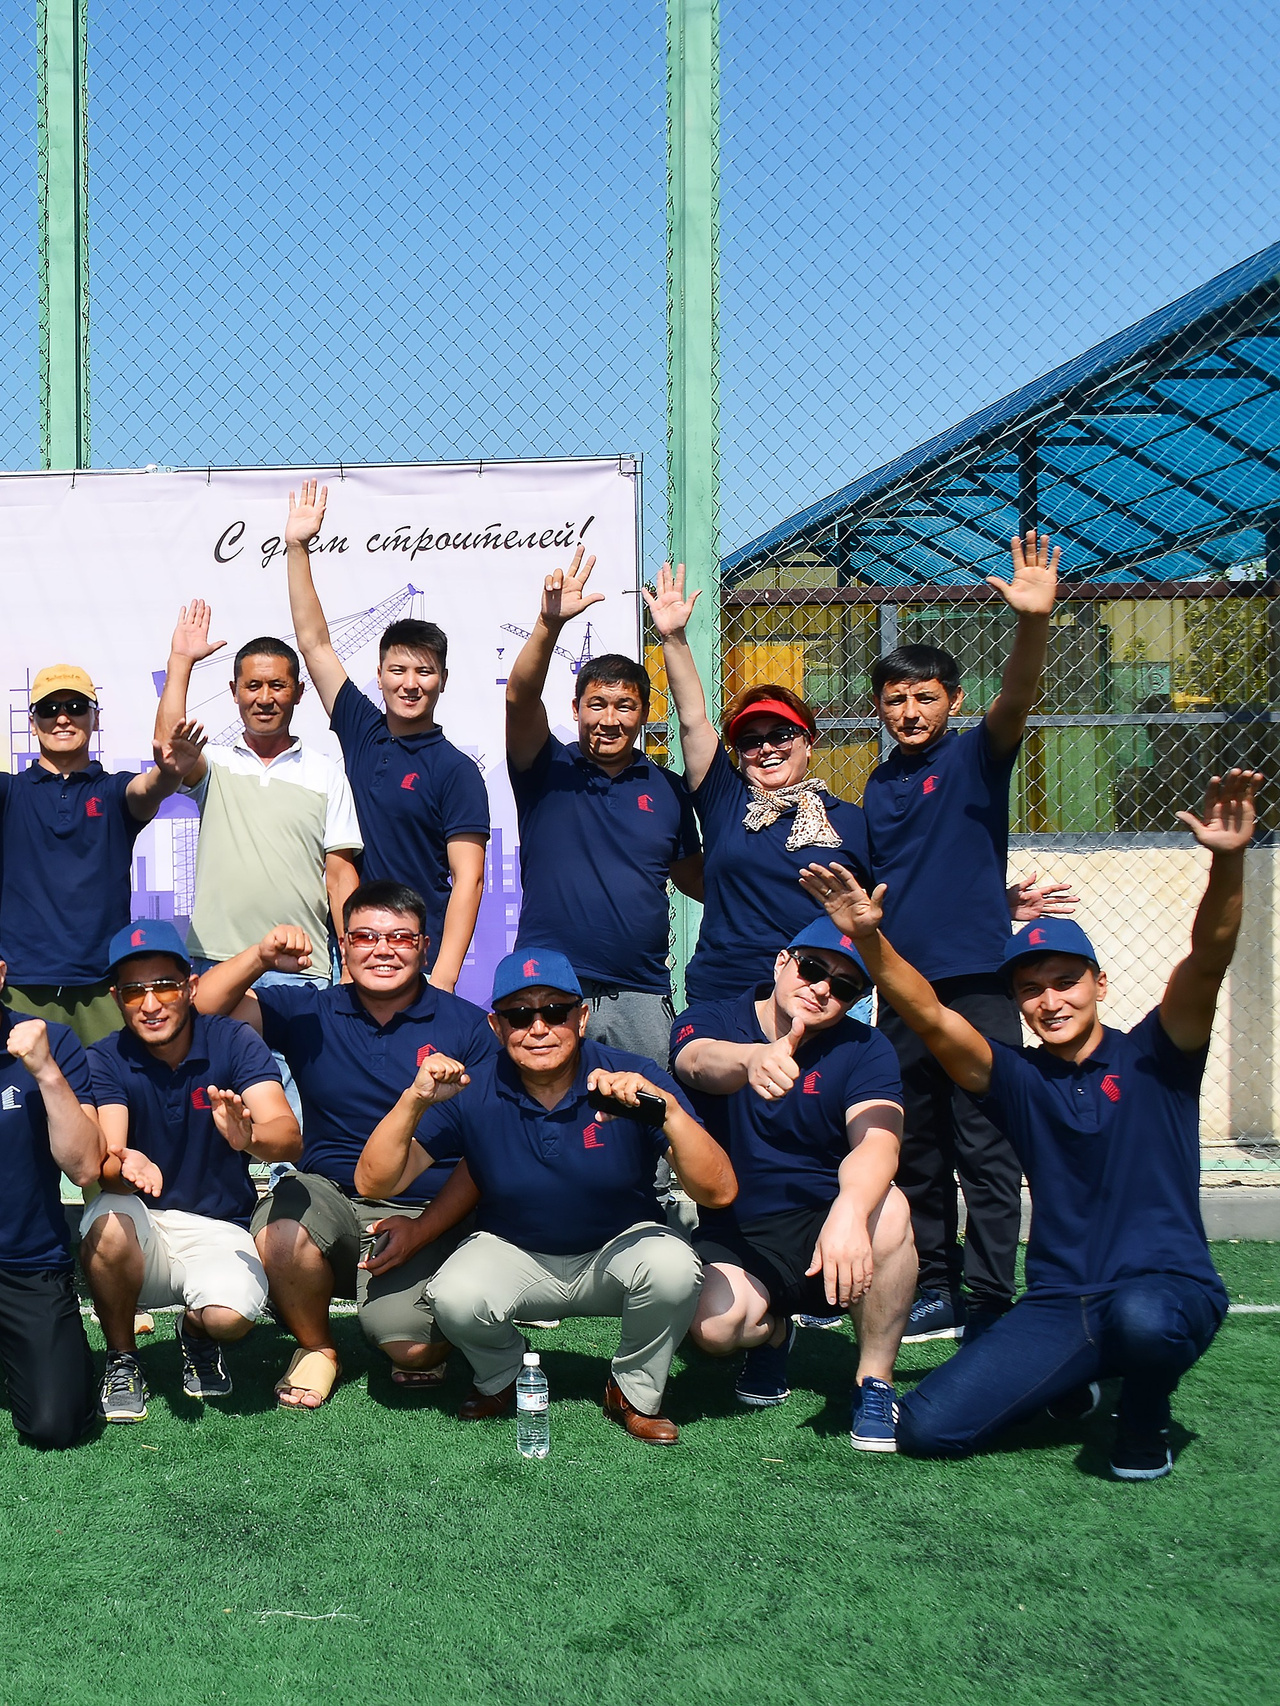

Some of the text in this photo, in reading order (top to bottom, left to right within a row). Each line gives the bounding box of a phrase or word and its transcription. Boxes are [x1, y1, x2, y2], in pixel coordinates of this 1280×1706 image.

[214, 515, 595, 568] С дем строителей!
